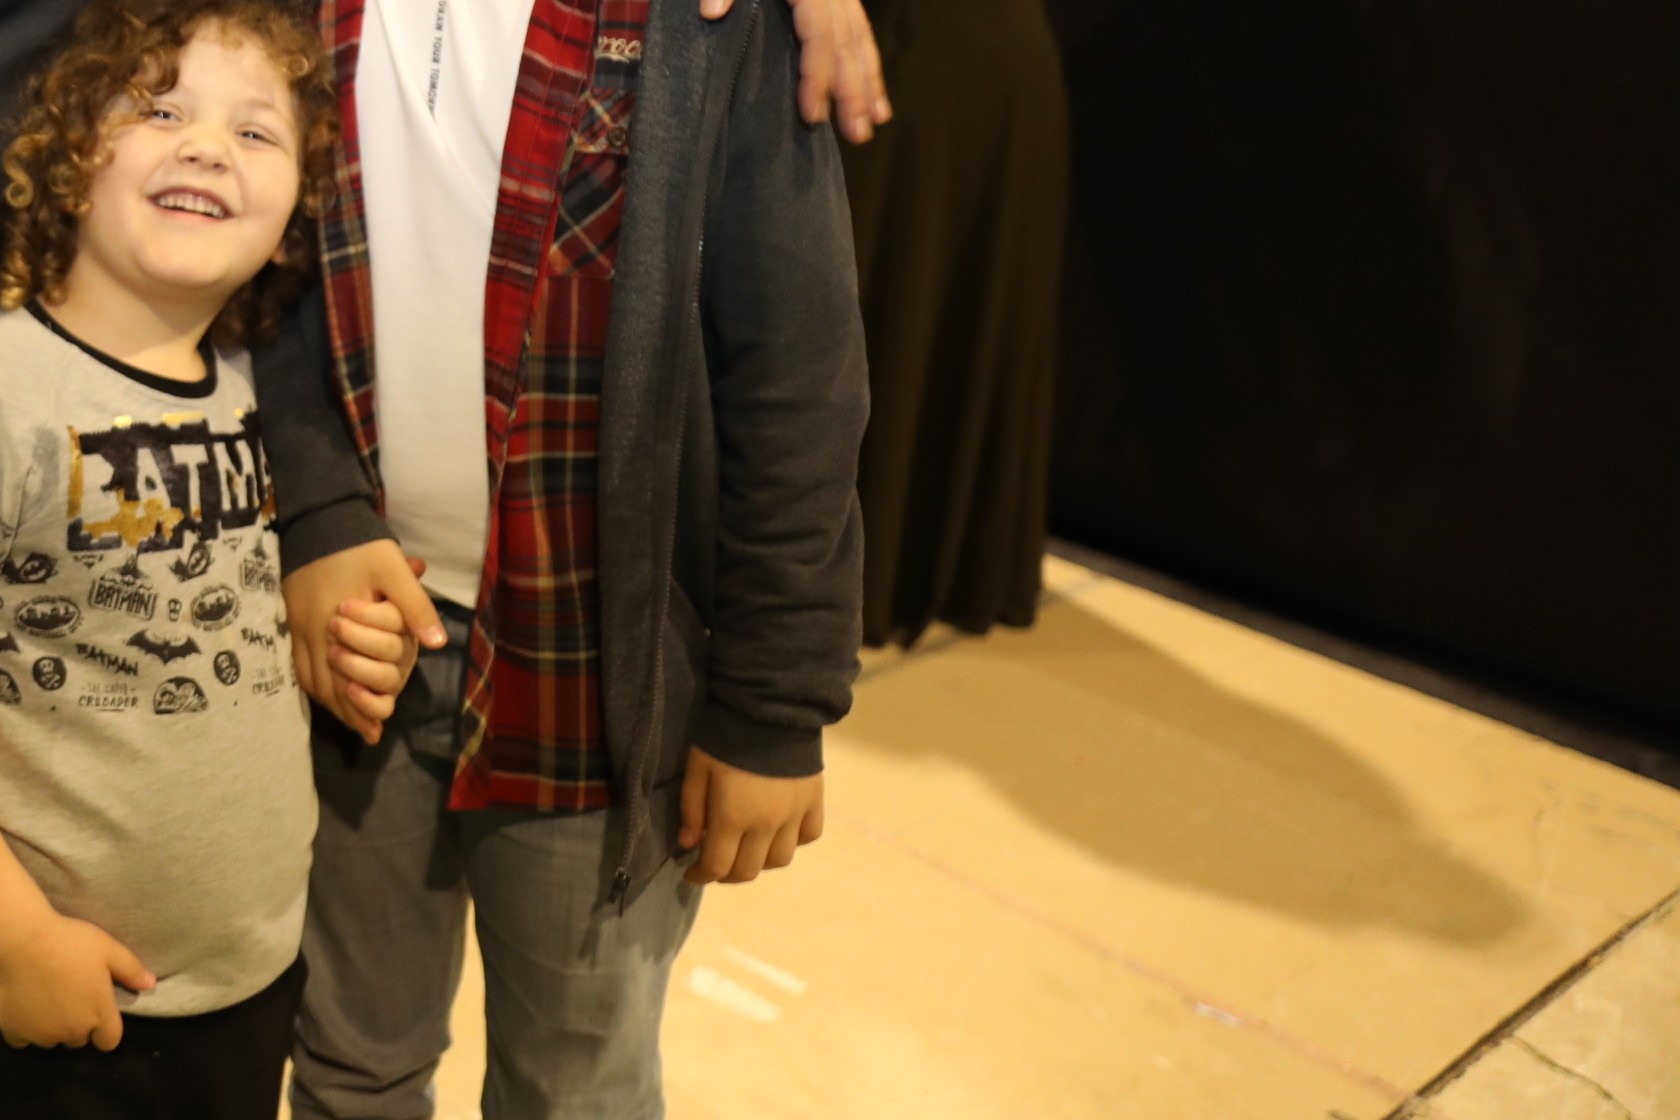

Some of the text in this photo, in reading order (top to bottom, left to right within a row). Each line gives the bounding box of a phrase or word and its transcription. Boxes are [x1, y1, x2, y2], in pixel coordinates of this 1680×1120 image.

[436, 0, 446, 32] DRAW
[432, 36, 442, 64] YOUR
[94, 582, 154, 616] BATMAN
